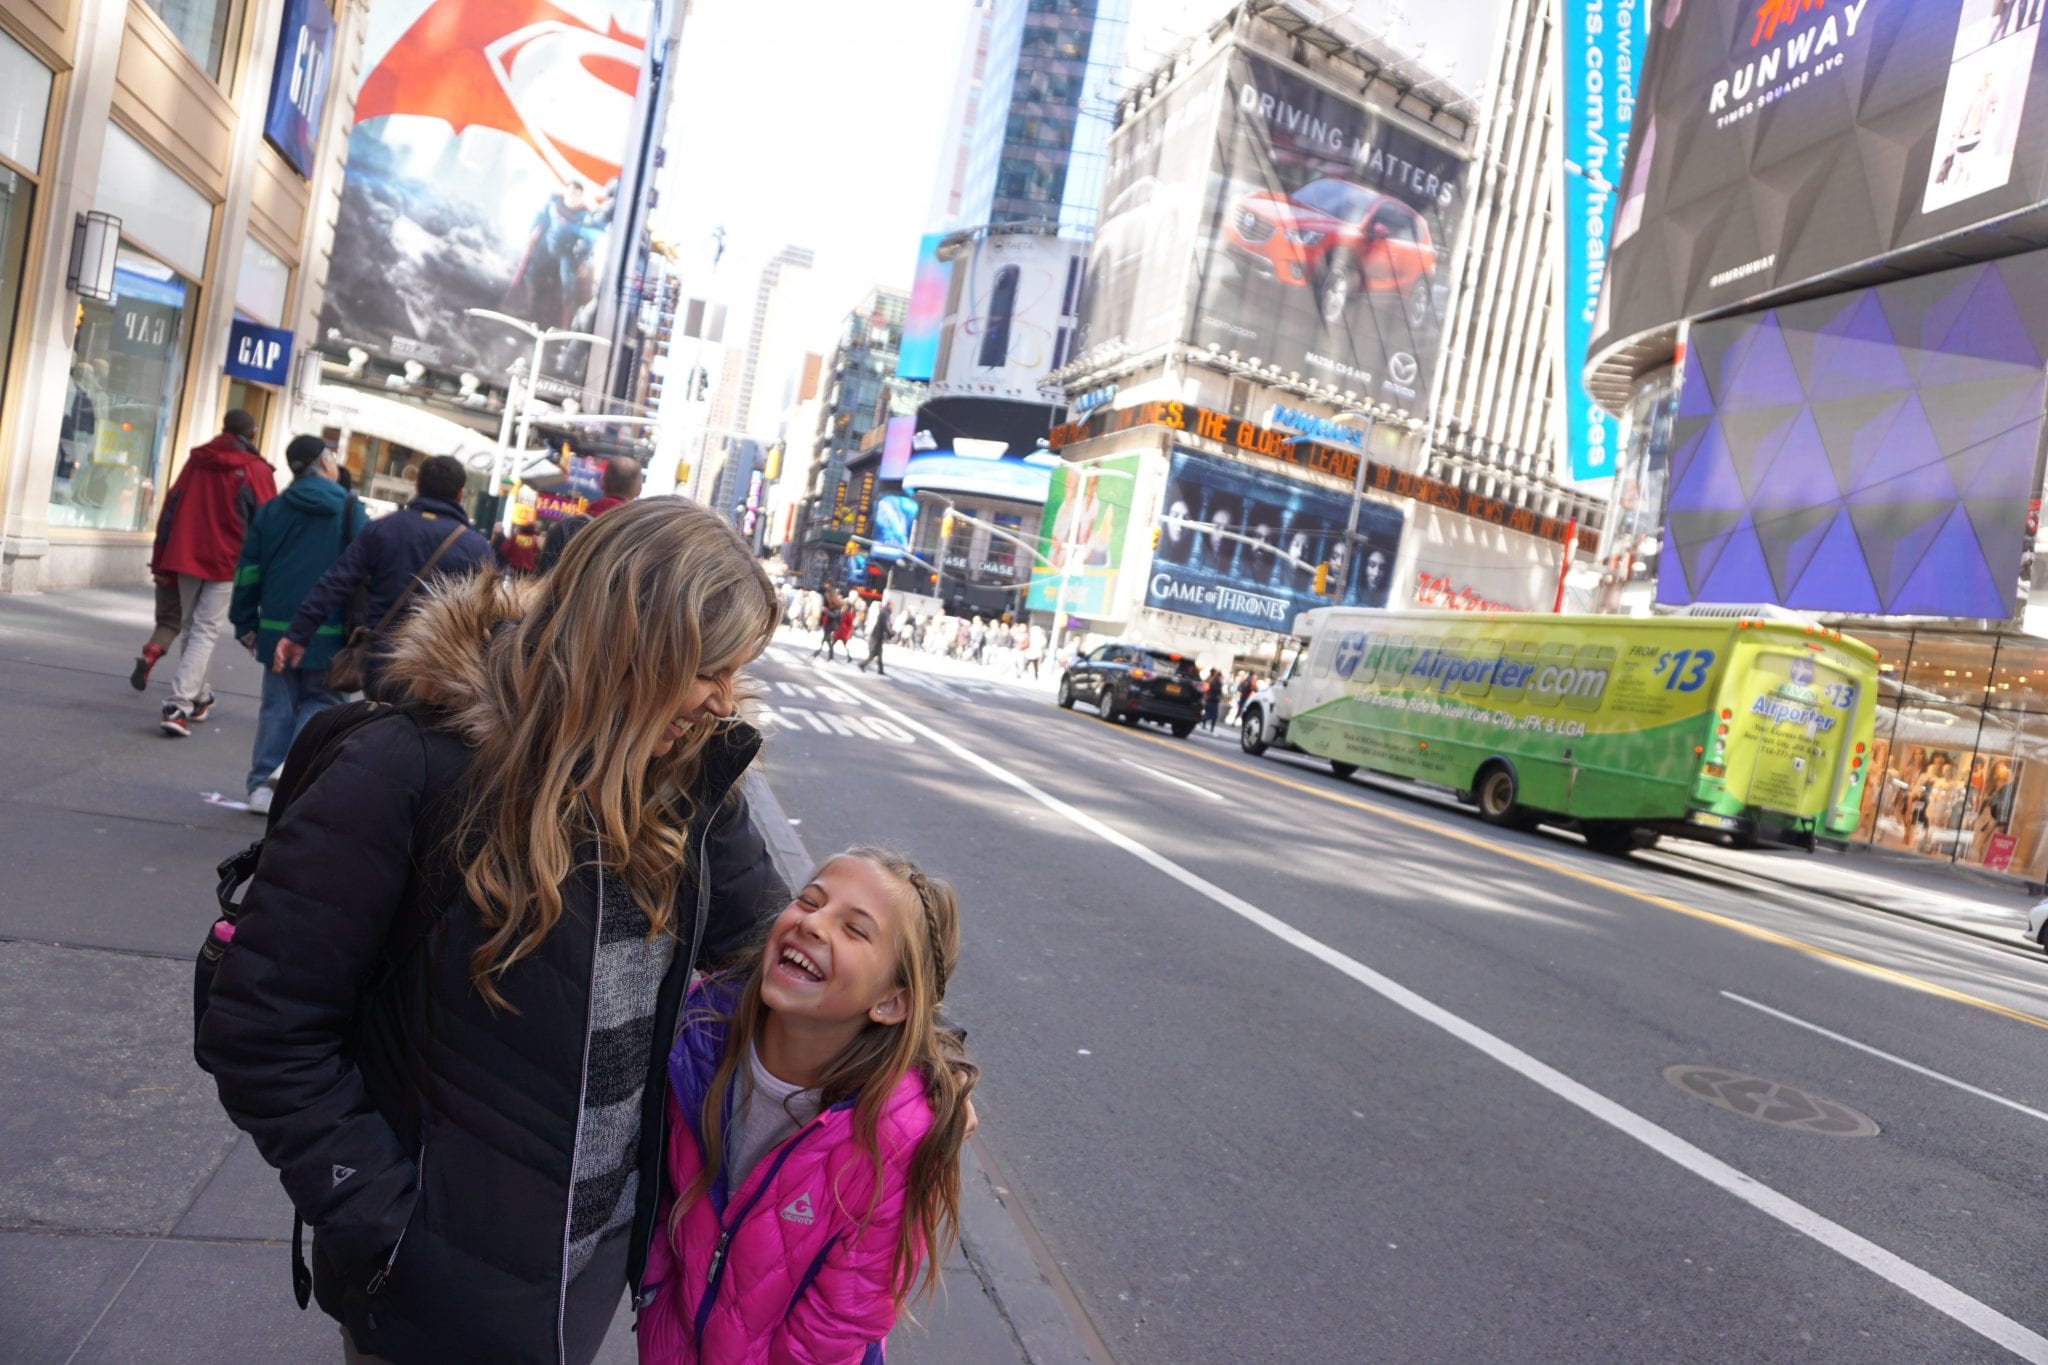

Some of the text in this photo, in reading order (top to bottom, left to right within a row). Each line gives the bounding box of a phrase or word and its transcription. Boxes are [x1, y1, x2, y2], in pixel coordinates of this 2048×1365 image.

[289, 24, 323, 123] GAP
[1709, 0, 1868, 114] RUNWAY
[1716, 52, 1844, 129] TIMES SQUARE NYC
[1240, 83, 1343, 151] DRIVING
[1352, 138, 1454, 206] MATTERS
[238, 335, 281, 371] GAP
[1196, 408, 1231, 442] THE
[1236, 420, 1298, 463] GLOBAL
[1397, 471, 1461, 511] BUSINESS
[1467, 492, 1503, 524] NEWS
[979, 560, 1015, 576] CHASE
[1151, 573, 1205, 603] GAME
[1216, 586, 1290, 621] THRONES
[1629, 646, 1659, 657] FROM
[1653, 649, 1715, 693] $13
[1373, 692, 1406, 710] Express
[1408, 697, 1429, 713] Ride
[1431, 702, 1441, 715] to
[1441, 702, 1466, 718] New
[1467, 706, 1490, 723] York
[1493, 710, 1517, 730] City,
[1520, 714, 1544, 731] JFK
[1546, 718, 1556, 733] &
[1557, 720, 1586, 737] LGA
[1752, 695, 1835, 731] Airporter
[1824, 683, 1855, 709] $13
